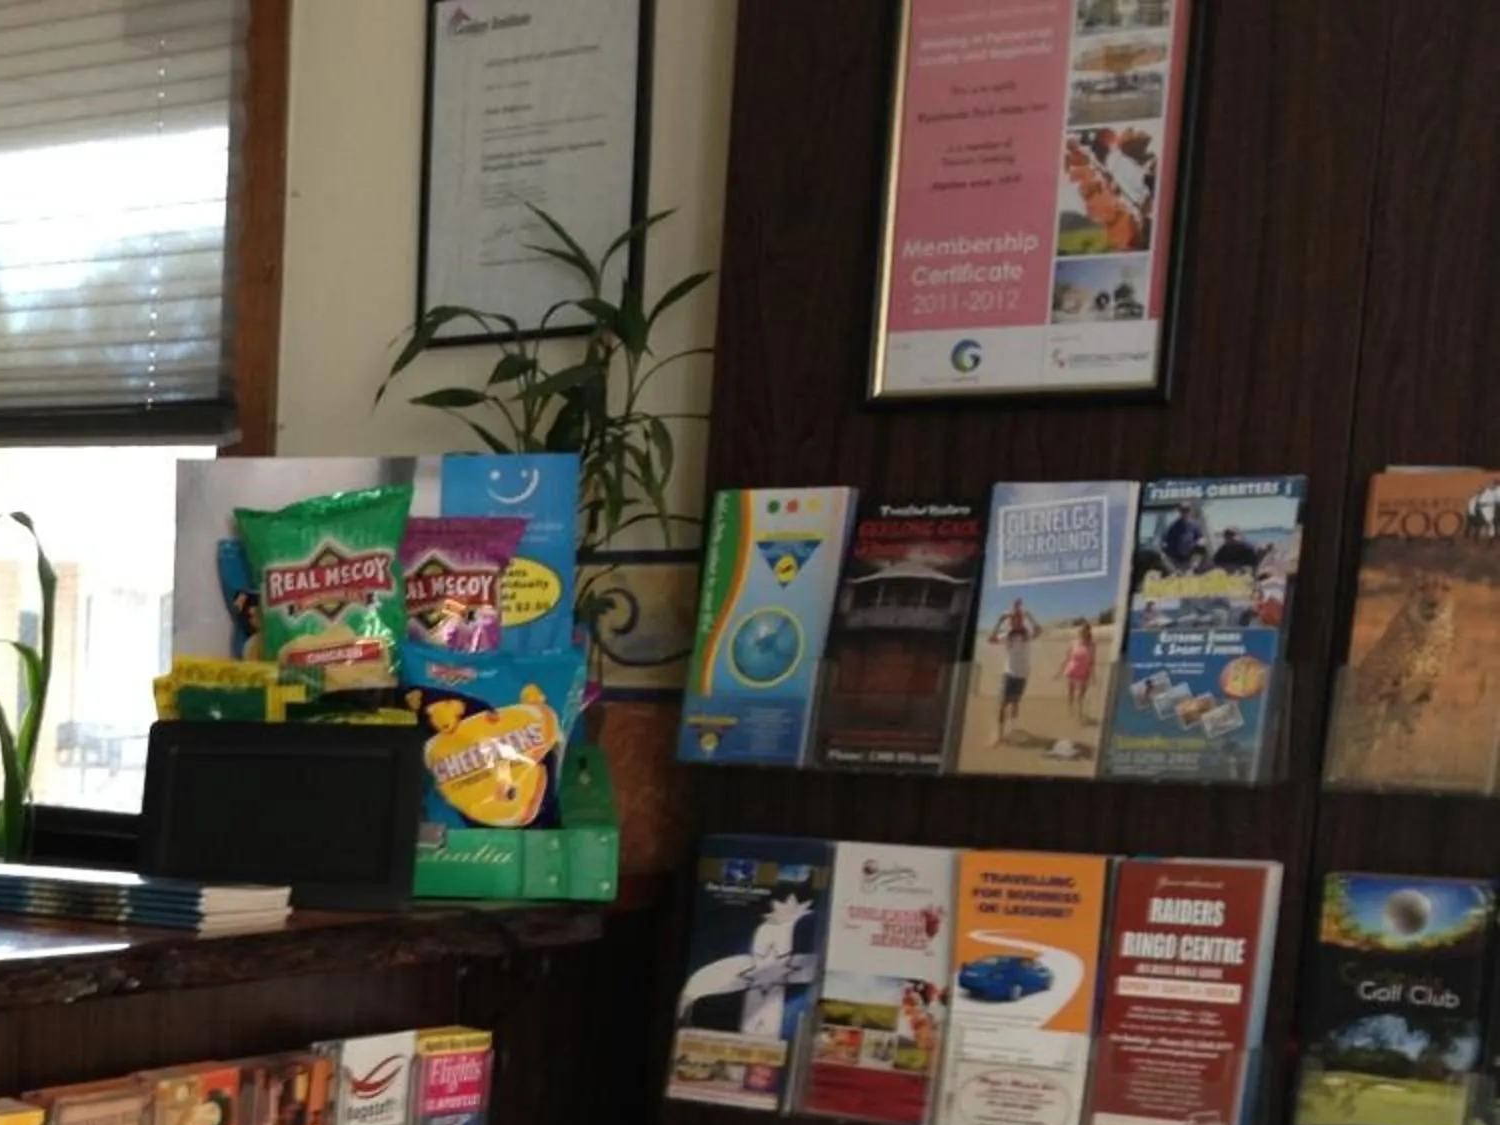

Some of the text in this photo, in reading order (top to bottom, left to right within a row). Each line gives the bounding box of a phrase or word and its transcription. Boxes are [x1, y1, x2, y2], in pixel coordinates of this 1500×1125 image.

[902, 229, 1040, 260] Membership
[911, 262, 1025, 287] Certificate
[912, 289, 1020, 316] 2011-2012
[1377, 510, 1464, 538] ZOO
[1004, 530, 1100, 559] SURROUNDS
[269, 567, 321, 599] REAL
[1148, 896, 1226, 927] RAIDERS
[1120, 931, 1247, 965] BINGO CENTRE
[1358, 980, 1460, 1009] Golf Club
